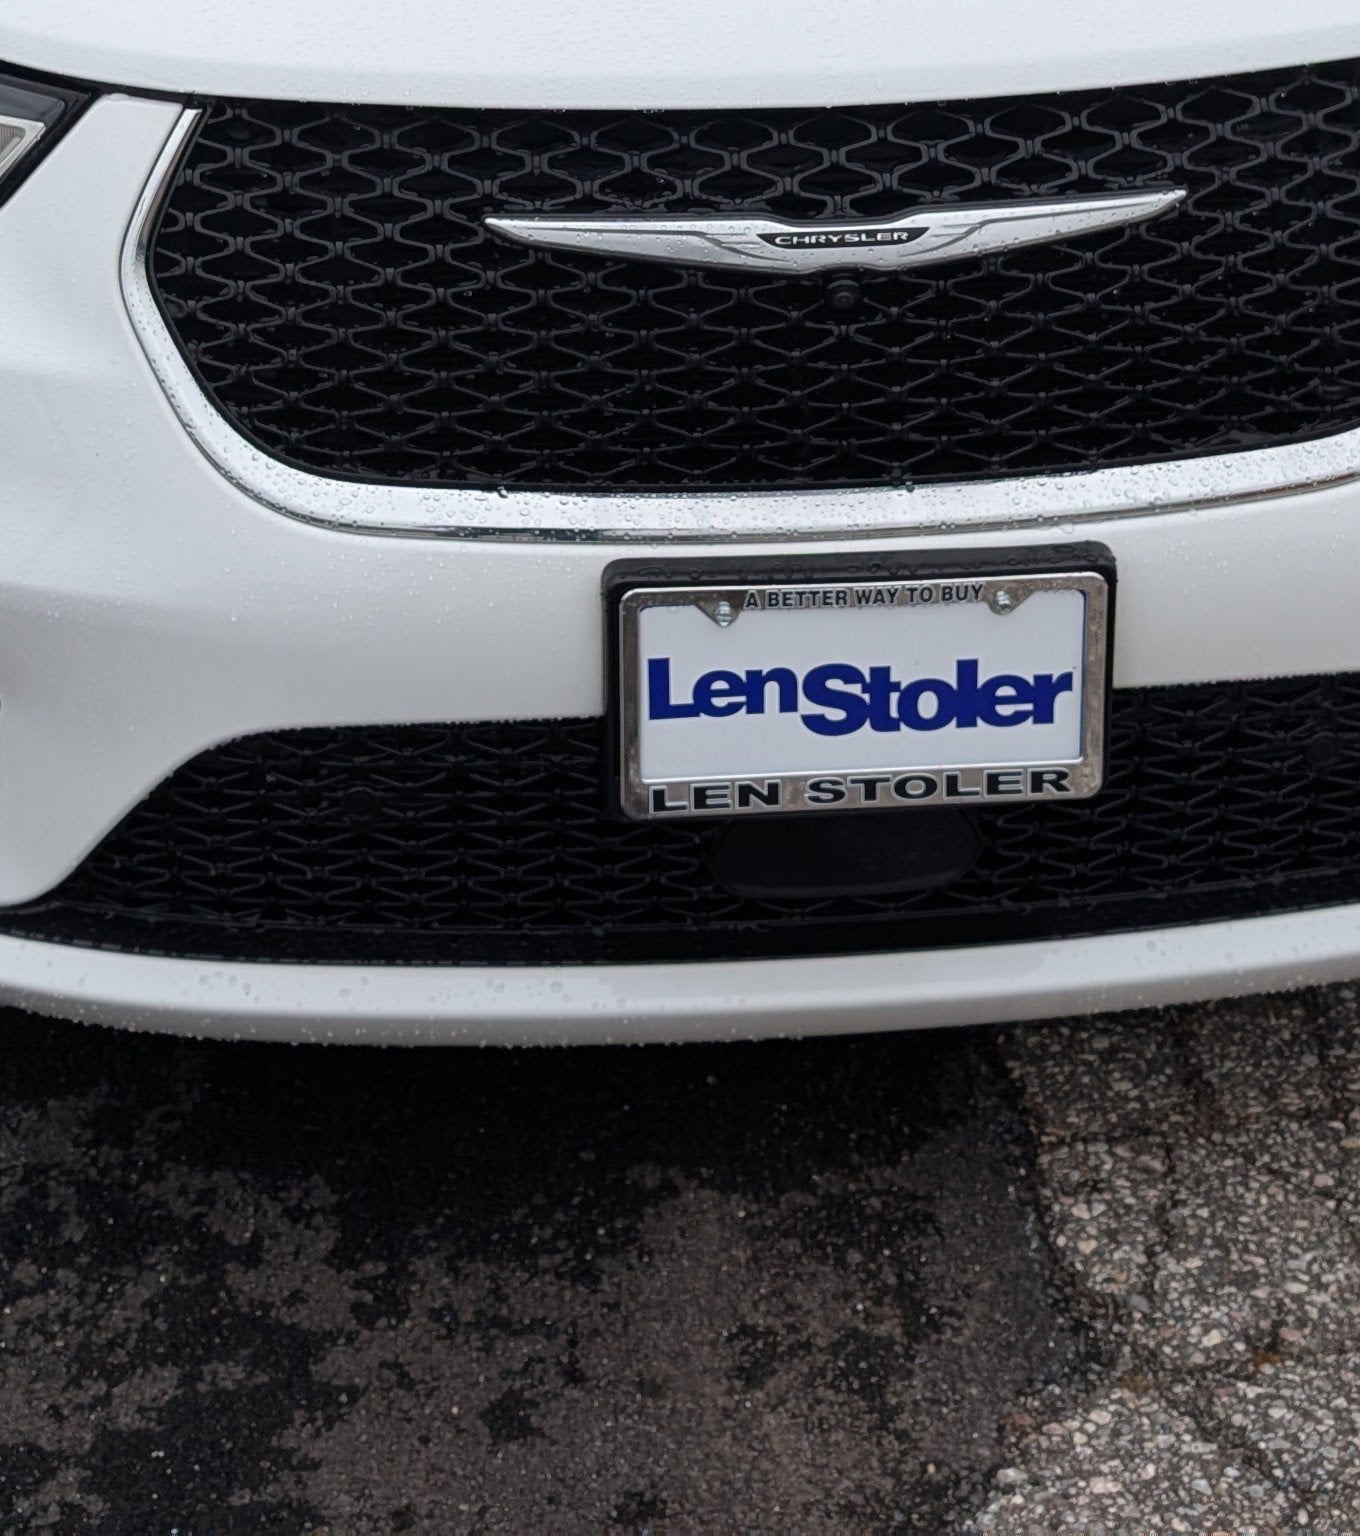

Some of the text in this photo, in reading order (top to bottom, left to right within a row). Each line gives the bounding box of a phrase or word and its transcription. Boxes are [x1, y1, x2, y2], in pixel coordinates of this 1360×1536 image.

[774, 231, 910, 246] CHRYSLER
[744, 582, 985, 609] A BETTER WAY TO BUY
[648, 766, 1074, 815] LEN STOLER
